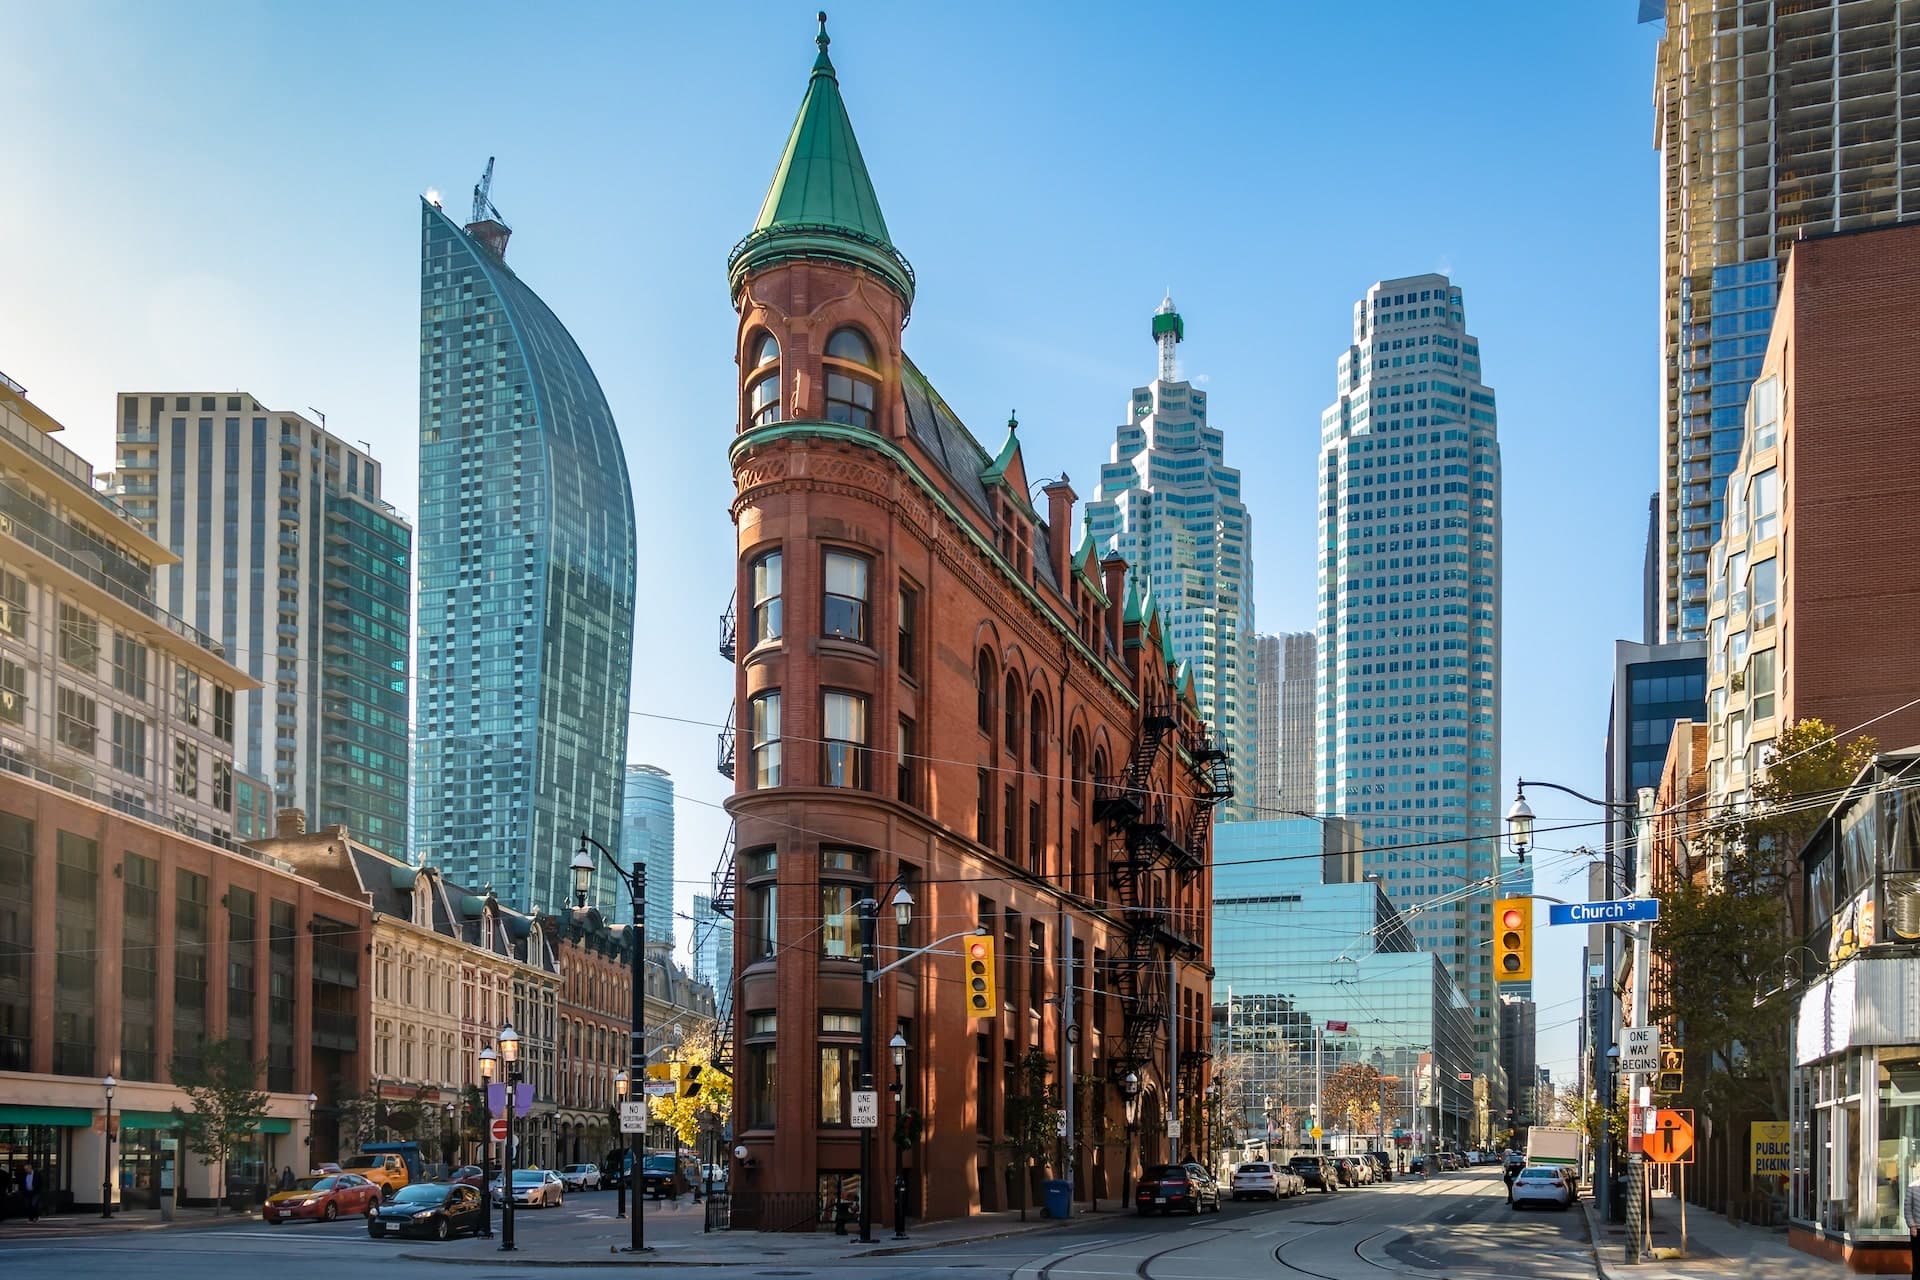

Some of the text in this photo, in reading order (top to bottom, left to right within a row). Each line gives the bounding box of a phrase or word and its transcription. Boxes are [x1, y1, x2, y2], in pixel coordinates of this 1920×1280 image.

[1571, 902, 1636, 919] Church St
[1630, 1031, 1649, 1041] ONE
[1630, 1045, 1649, 1055] WAY
[1622, 1058, 1657, 1070] BEGINS
[857, 1094, 871, 1103] ONE
[629, 1104, 639, 1114] NO
[857, 1105, 871, 1113] WAY
[852, 1115, 876, 1124] BEGINS
[1756, 1142, 1790, 1155] PUBLIC
